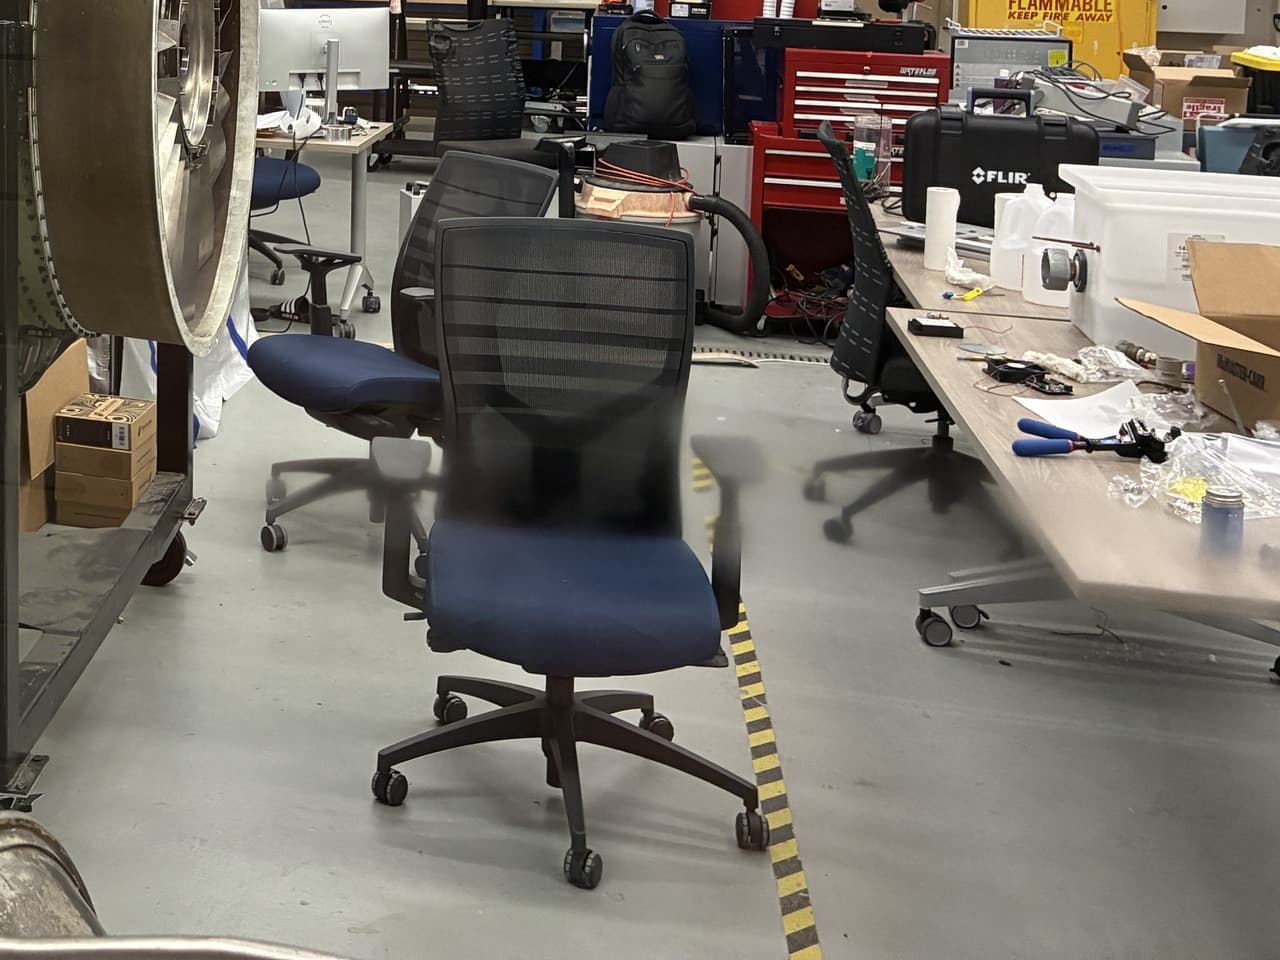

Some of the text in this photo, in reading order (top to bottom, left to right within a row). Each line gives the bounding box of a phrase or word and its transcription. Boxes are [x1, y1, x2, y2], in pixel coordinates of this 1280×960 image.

[1008, 11, 1113, 22] KEEP FIRE AWAY
[986, 170, 1028, 184] FLIR
